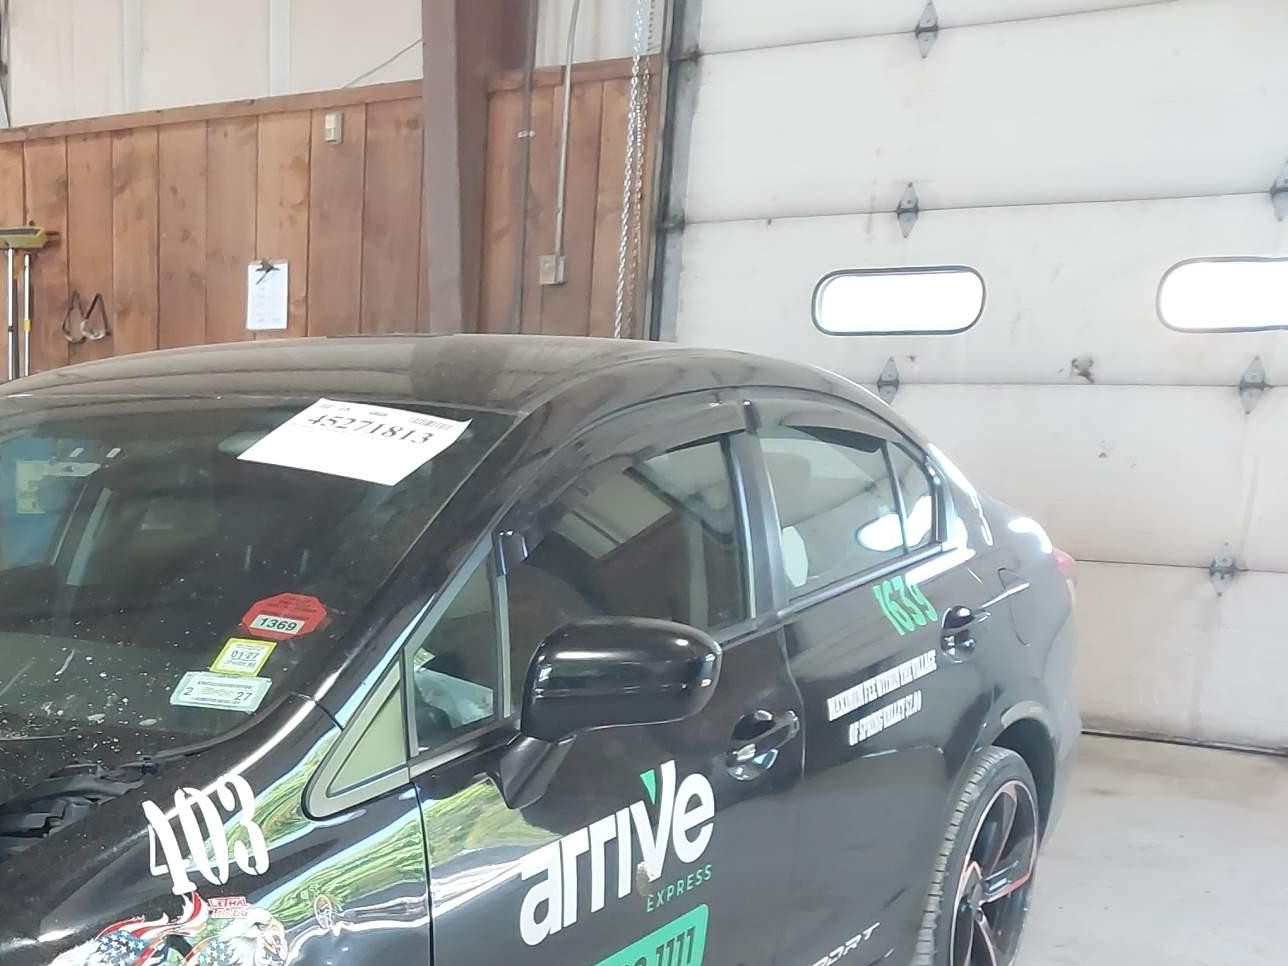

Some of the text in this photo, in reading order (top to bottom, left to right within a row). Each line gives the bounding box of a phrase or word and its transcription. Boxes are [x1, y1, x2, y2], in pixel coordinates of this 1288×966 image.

[308, 415, 434, 443] 45271813
[260, 617, 297, 631] 1369
[184, 687, 193, 695] 2
[235, 691, 253, 701] 27
[646, 864, 712, 913] EXPRESS
